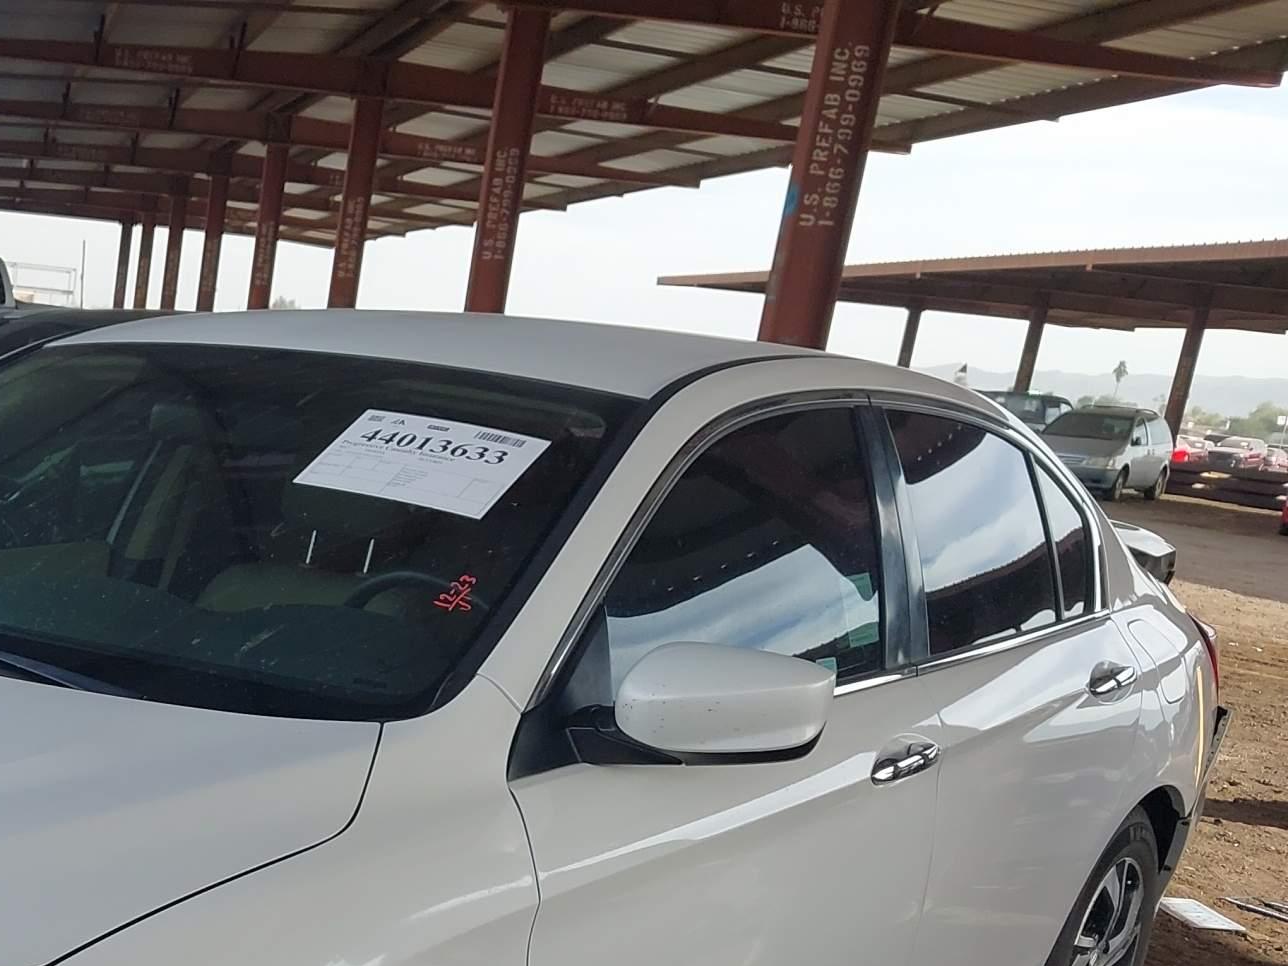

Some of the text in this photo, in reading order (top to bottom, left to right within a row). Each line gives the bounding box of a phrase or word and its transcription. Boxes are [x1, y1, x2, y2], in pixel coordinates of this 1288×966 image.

[799, 41, 853, 227] U.S. PREFAB INC.
[818, 45, 870, 226] 1-866-799-0969
[486, 178, 503, 229] PREFAB
[360, 428, 509, 465] 44013633
